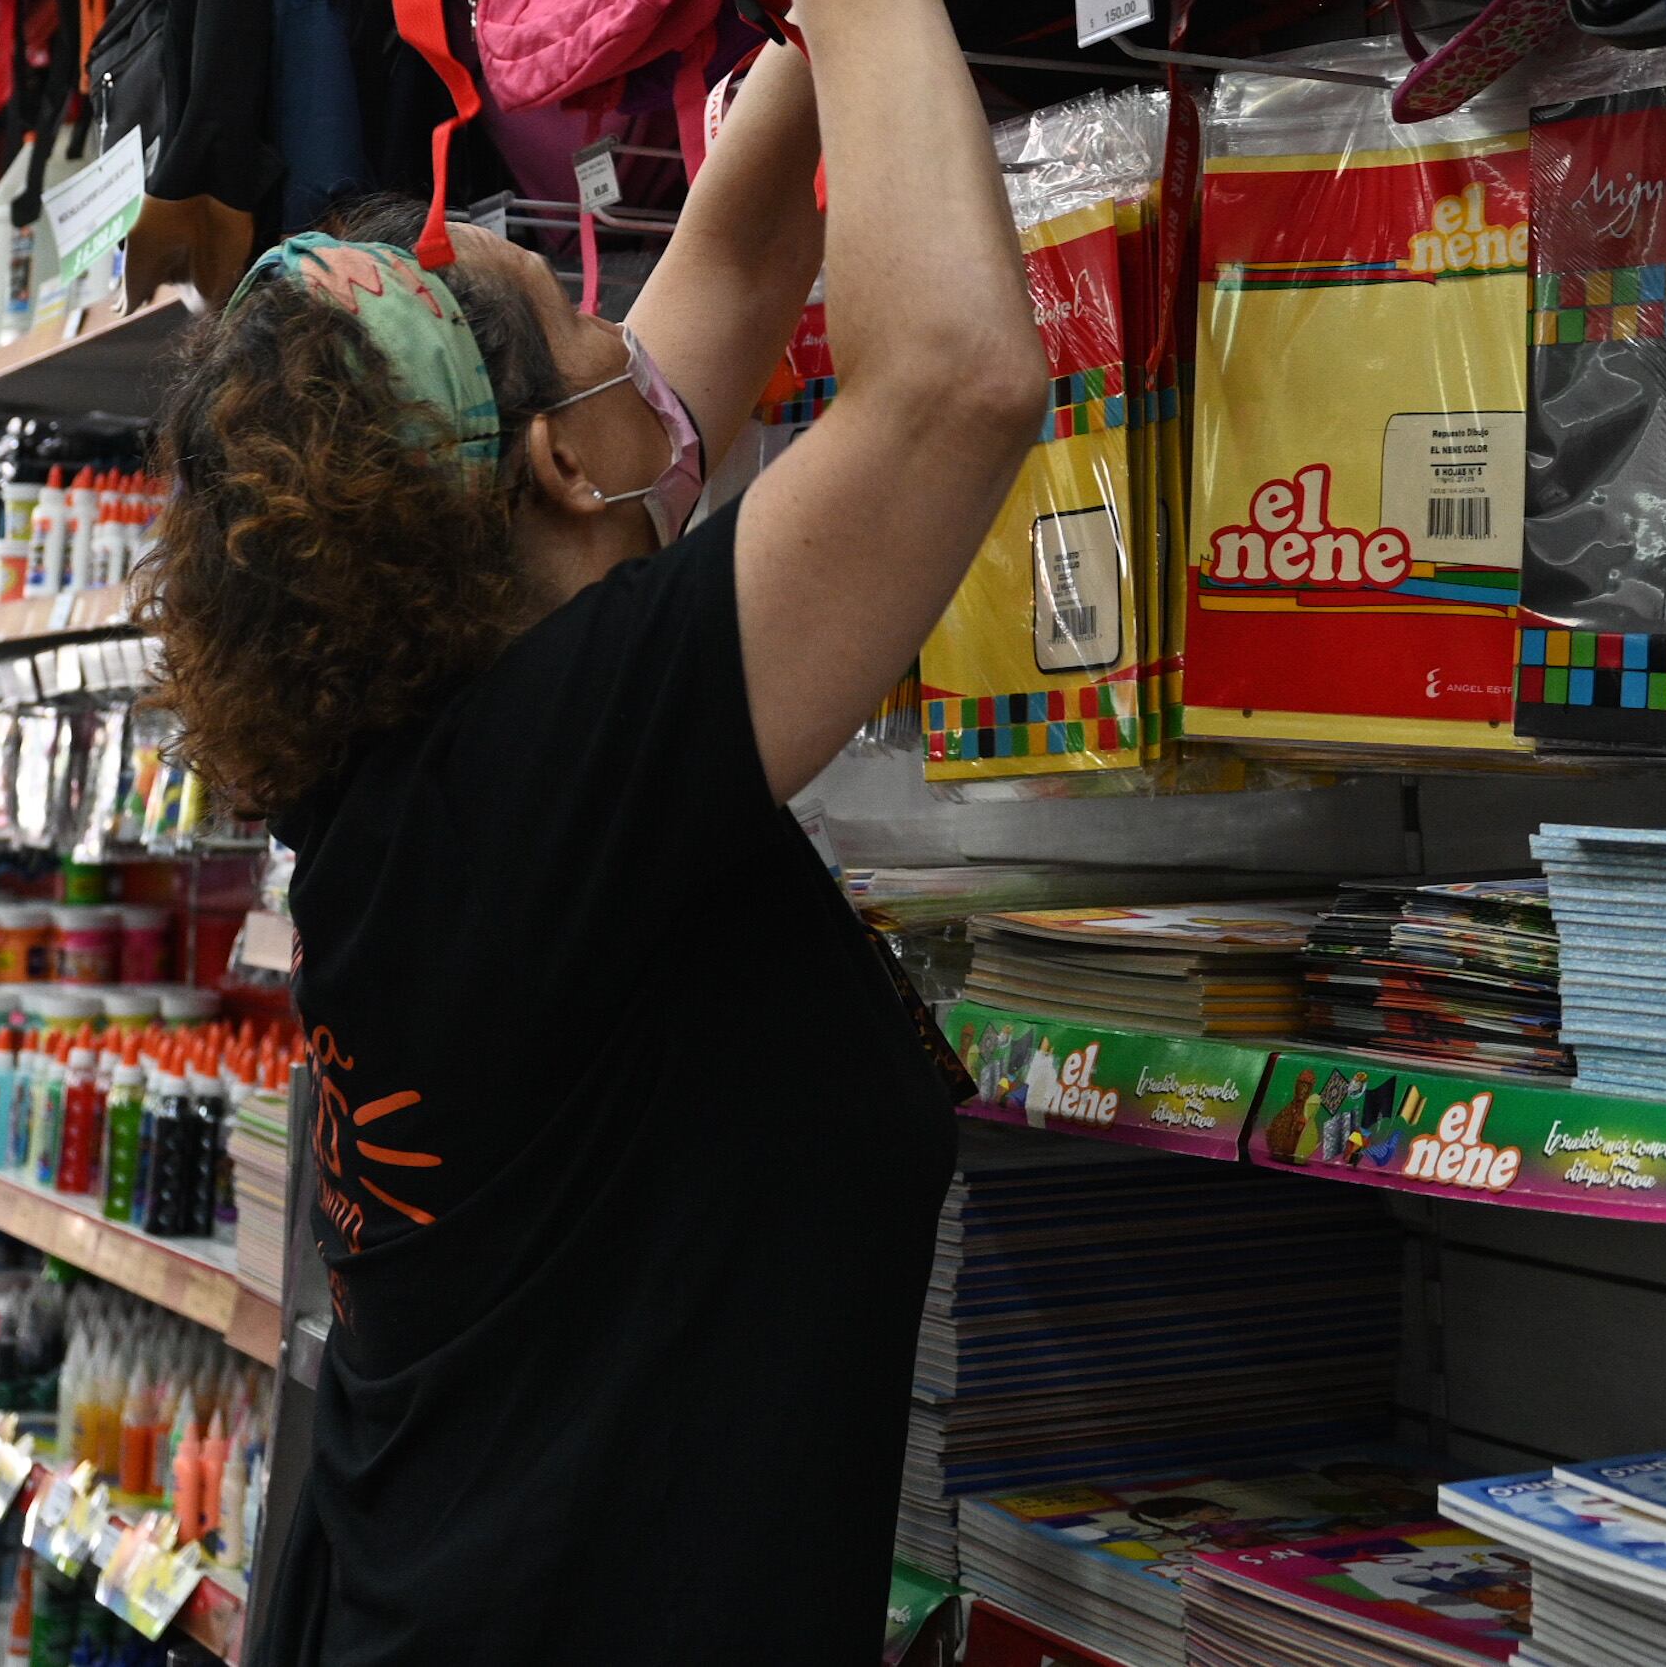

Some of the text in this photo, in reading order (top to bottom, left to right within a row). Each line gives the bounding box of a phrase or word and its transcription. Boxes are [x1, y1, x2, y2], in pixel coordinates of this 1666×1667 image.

[1104, 0, 1137, 23] 150.00
[1169, 138, 1189, 200] RIVER
[1436, 184, 1483, 234] el
[1412, 224, 1528, 272] nene
[1431, 443, 1488, 454] EL NENE COLOR
[1467, 428, 1490, 439] Dibujo
[1442, 467, 1467, 476] HOJAS
[1254, 469, 1325, 533] el
[1215, 533, 1406, 583] nene
[1446, 683, 1484, 693] ANGEL
[1062, 1043, 1099, 1088] el
[1198, 1077, 1240, 1102] completo
[1440, 1095, 1490, 1145] el
[1404, 1138, 1519, 1188] nene
[1565, 1158, 1610, 1184] dibujar
